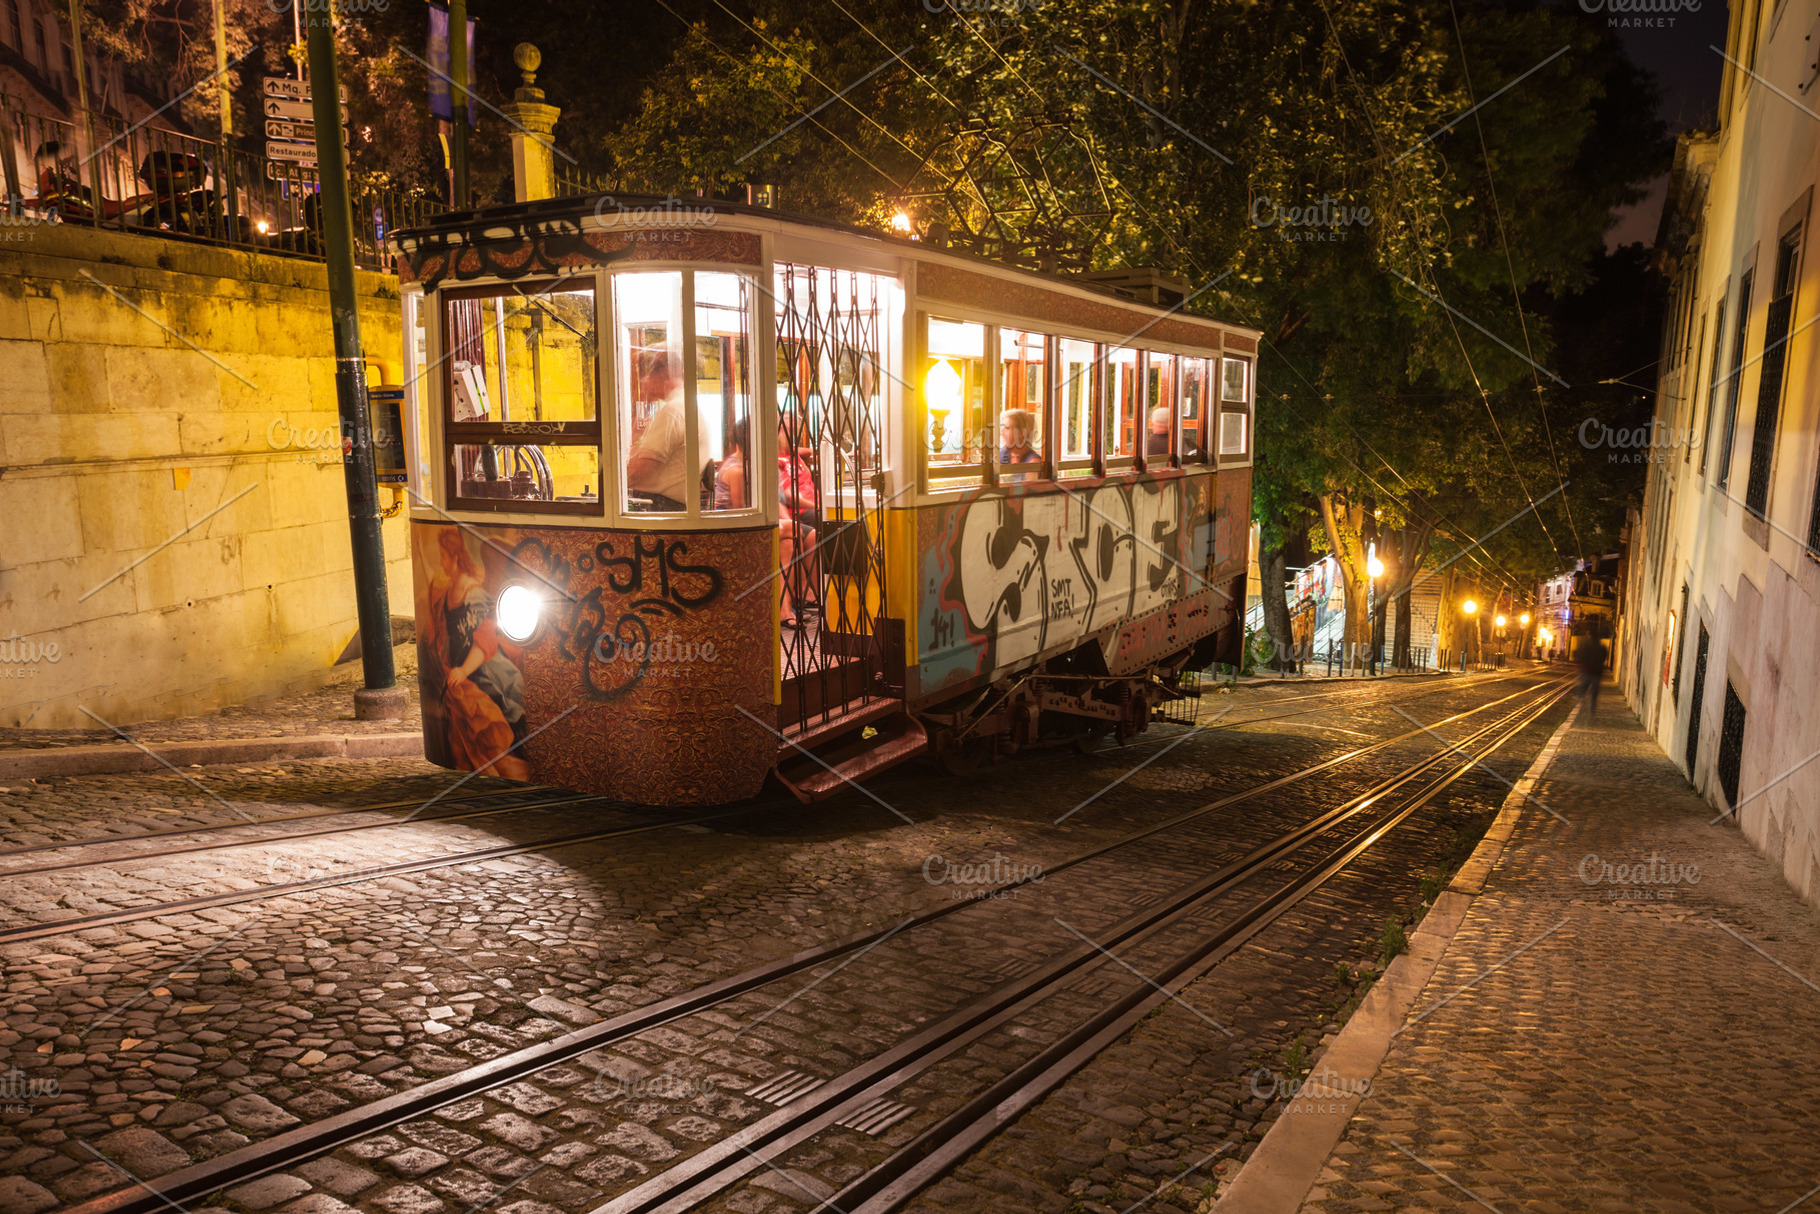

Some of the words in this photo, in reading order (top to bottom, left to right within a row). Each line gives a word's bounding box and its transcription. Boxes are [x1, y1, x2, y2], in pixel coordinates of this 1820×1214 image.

[282, 83, 301, 95] Mq.
[270, 146, 317, 158] Restaurado
[1051, 578, 1072, 598] SMT
